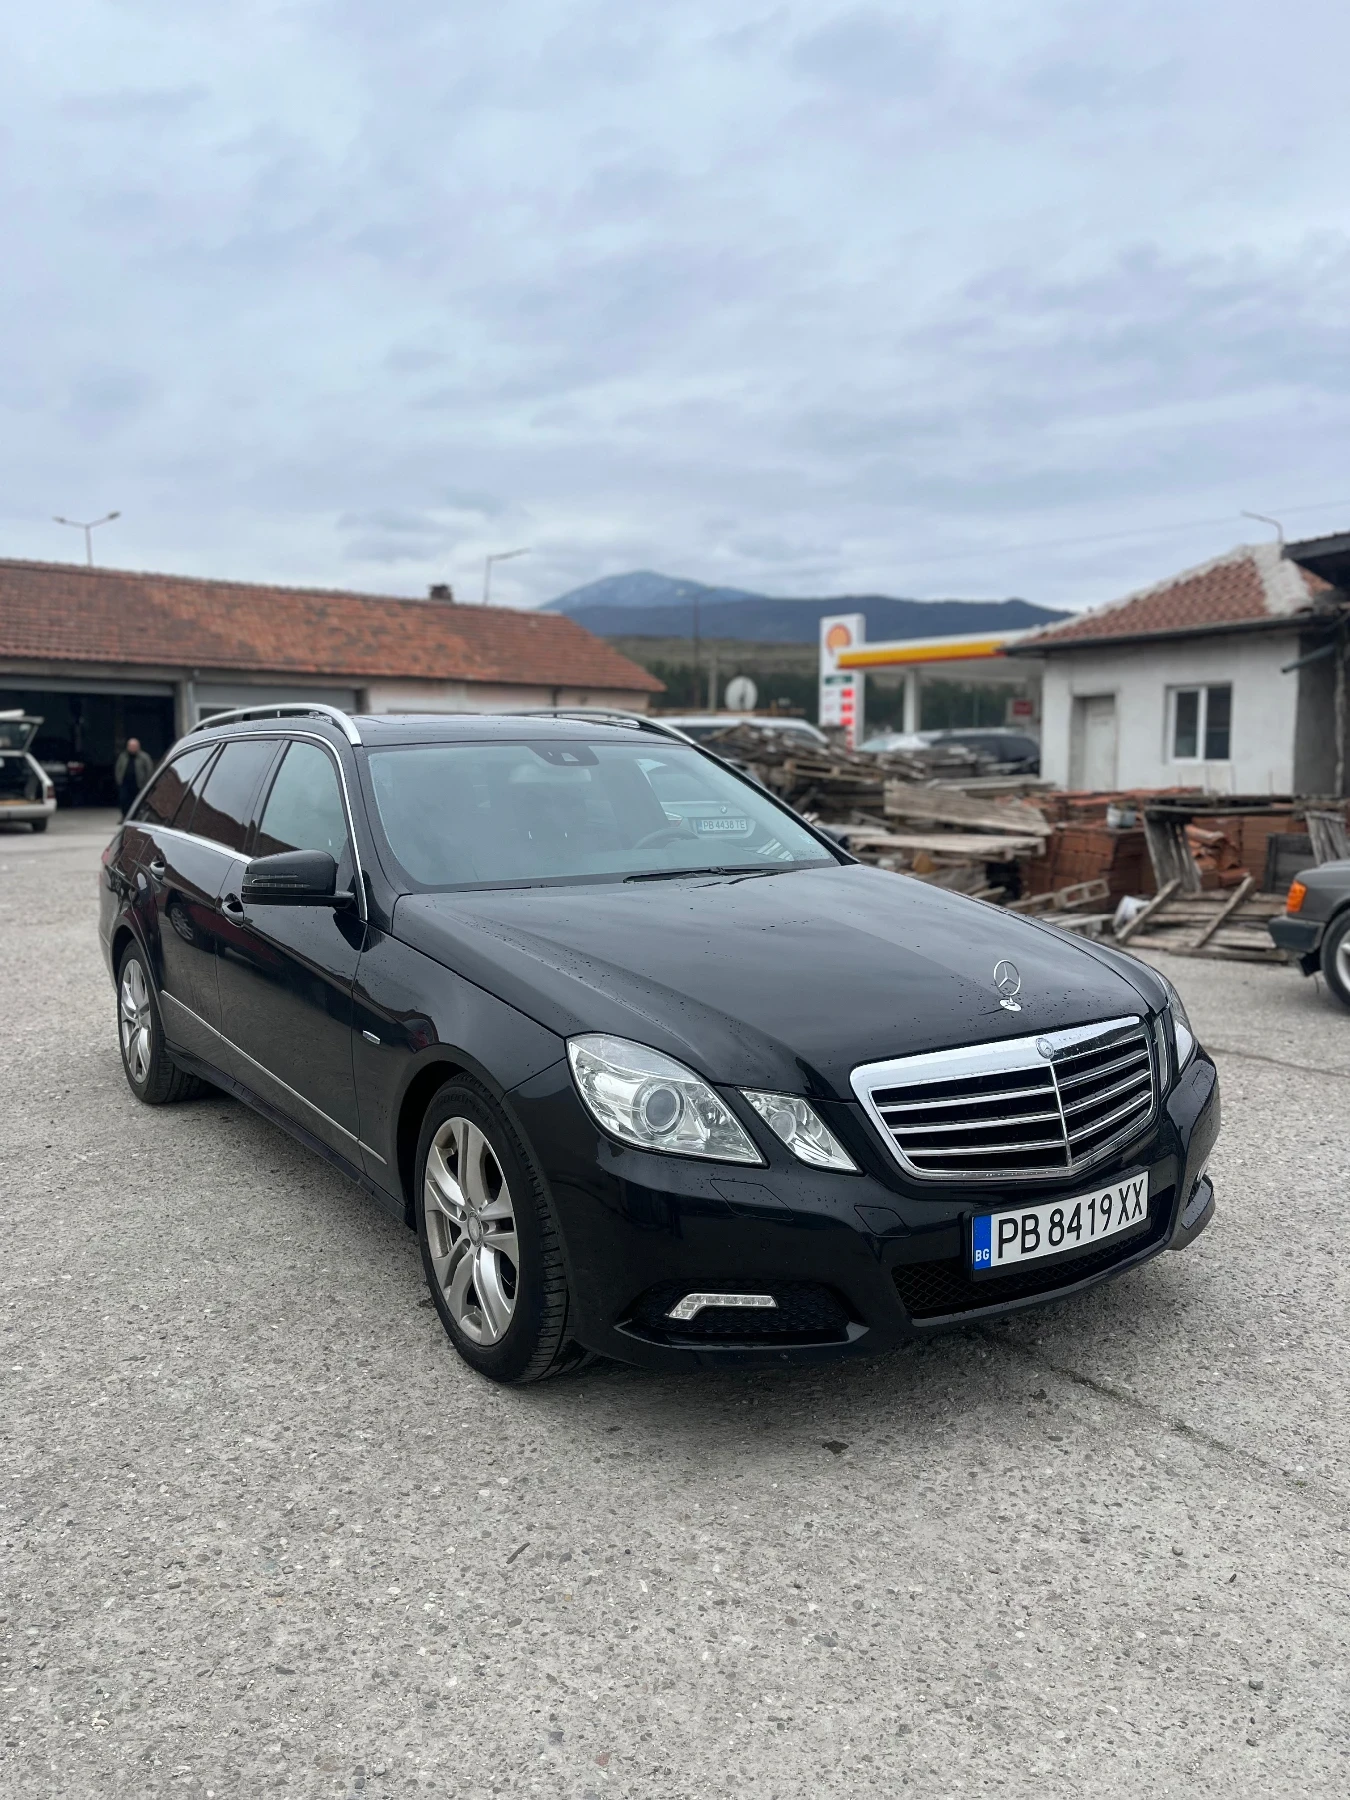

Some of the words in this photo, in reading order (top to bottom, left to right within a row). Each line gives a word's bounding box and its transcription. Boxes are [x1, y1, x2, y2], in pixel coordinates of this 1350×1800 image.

[703, 820, 714, 829] PB
[736, 820, 746, 829] TE
[997, 1213, 1041, 1259] PB
[1048, 1193, 1113, 1247] 8419
[1117, 1178, 1144, 1226] XX
[975, 1248, 990, 1262] BG
